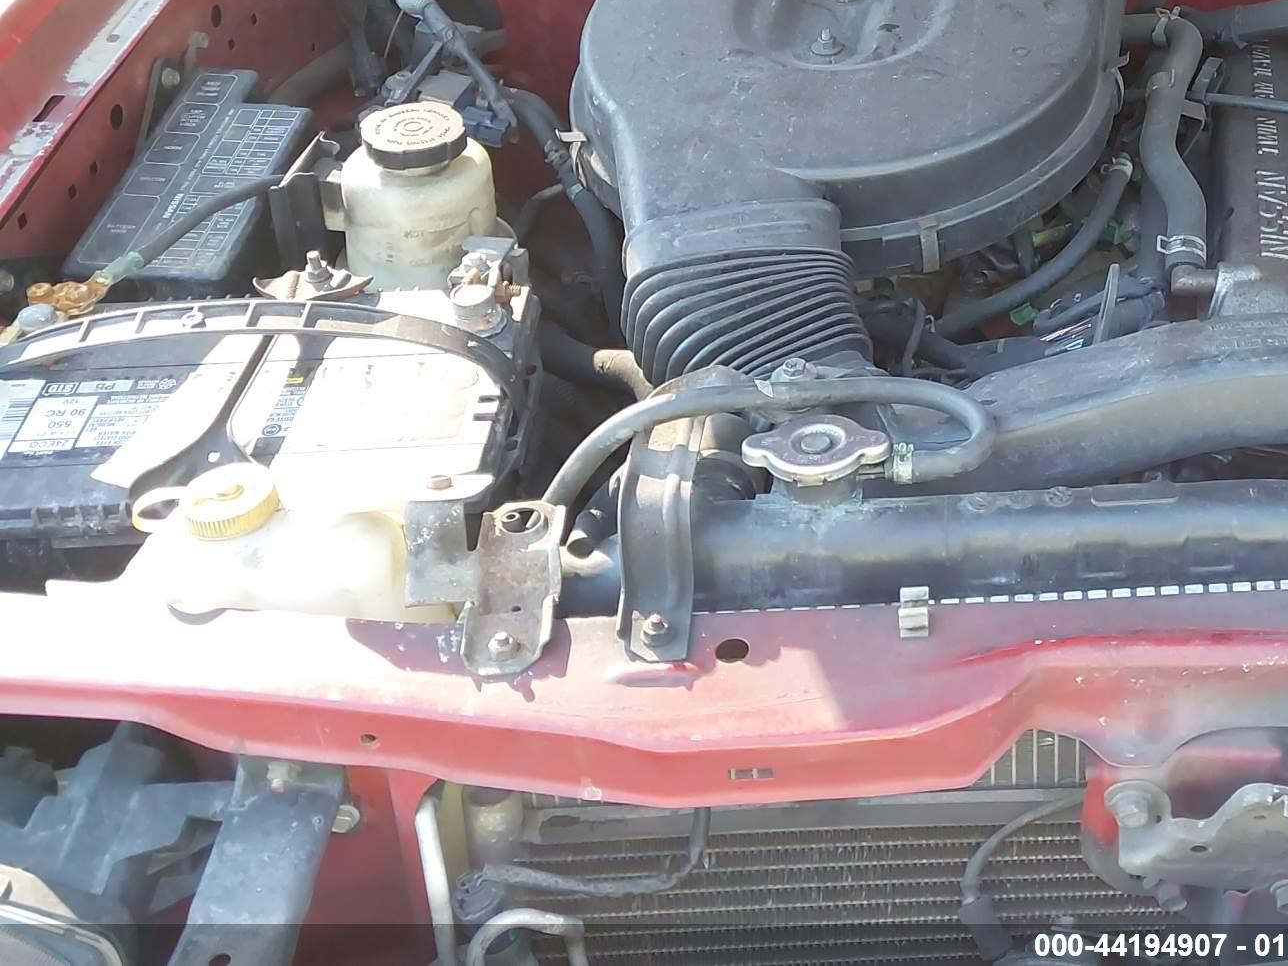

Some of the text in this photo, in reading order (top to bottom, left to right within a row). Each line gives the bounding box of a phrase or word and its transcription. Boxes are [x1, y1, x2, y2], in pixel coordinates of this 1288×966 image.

[47, 384, 73, 393] STD
[95, 383, 115, 391] Pb
[45, 408, 87, 417] 90 RC
[47, 420, 72, 429] 550
